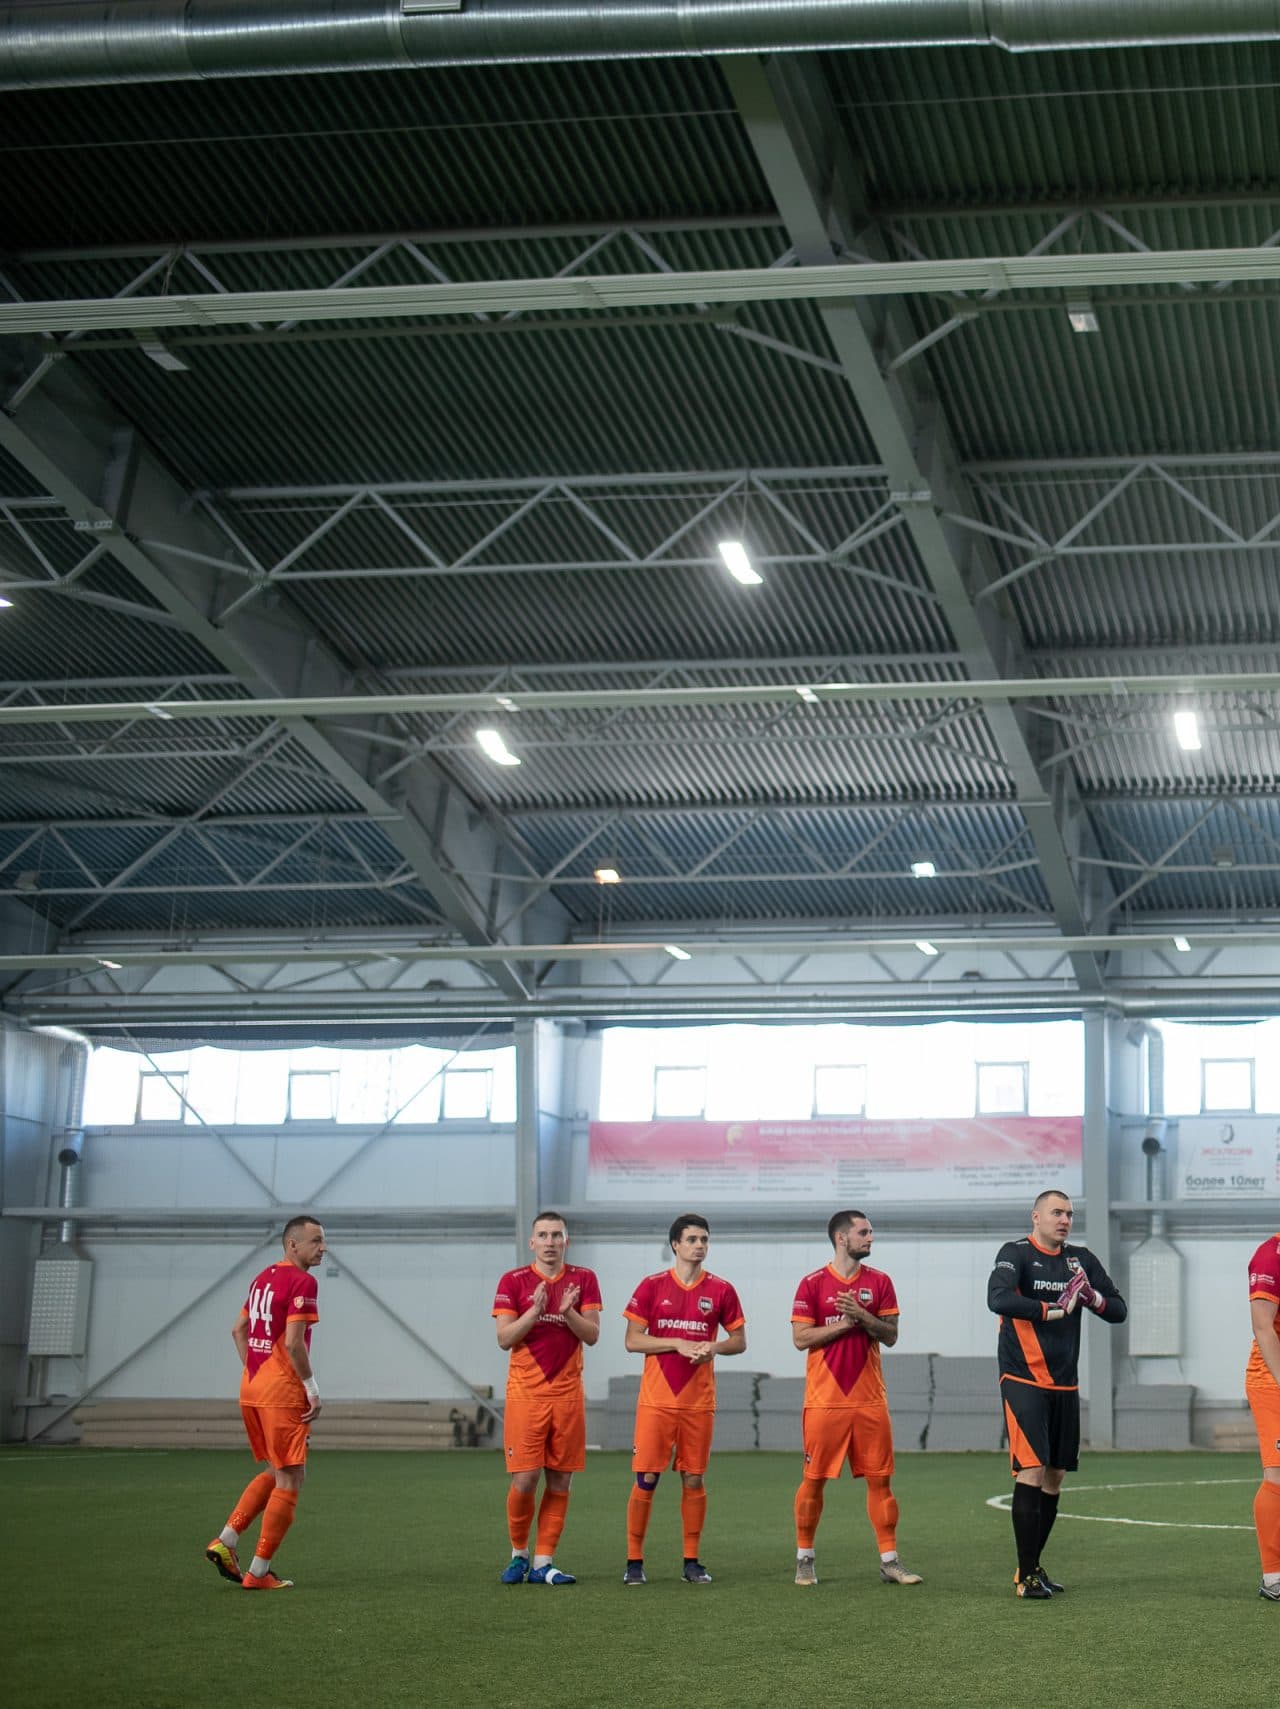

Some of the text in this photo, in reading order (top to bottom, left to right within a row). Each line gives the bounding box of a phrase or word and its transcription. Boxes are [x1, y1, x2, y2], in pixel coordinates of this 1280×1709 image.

[1185, 1175, 1266, 1187] более 10лет
[250, 1280, 275, 1337] 44
[657, 1318, 709, 1331] ПРОДИНВЕС
